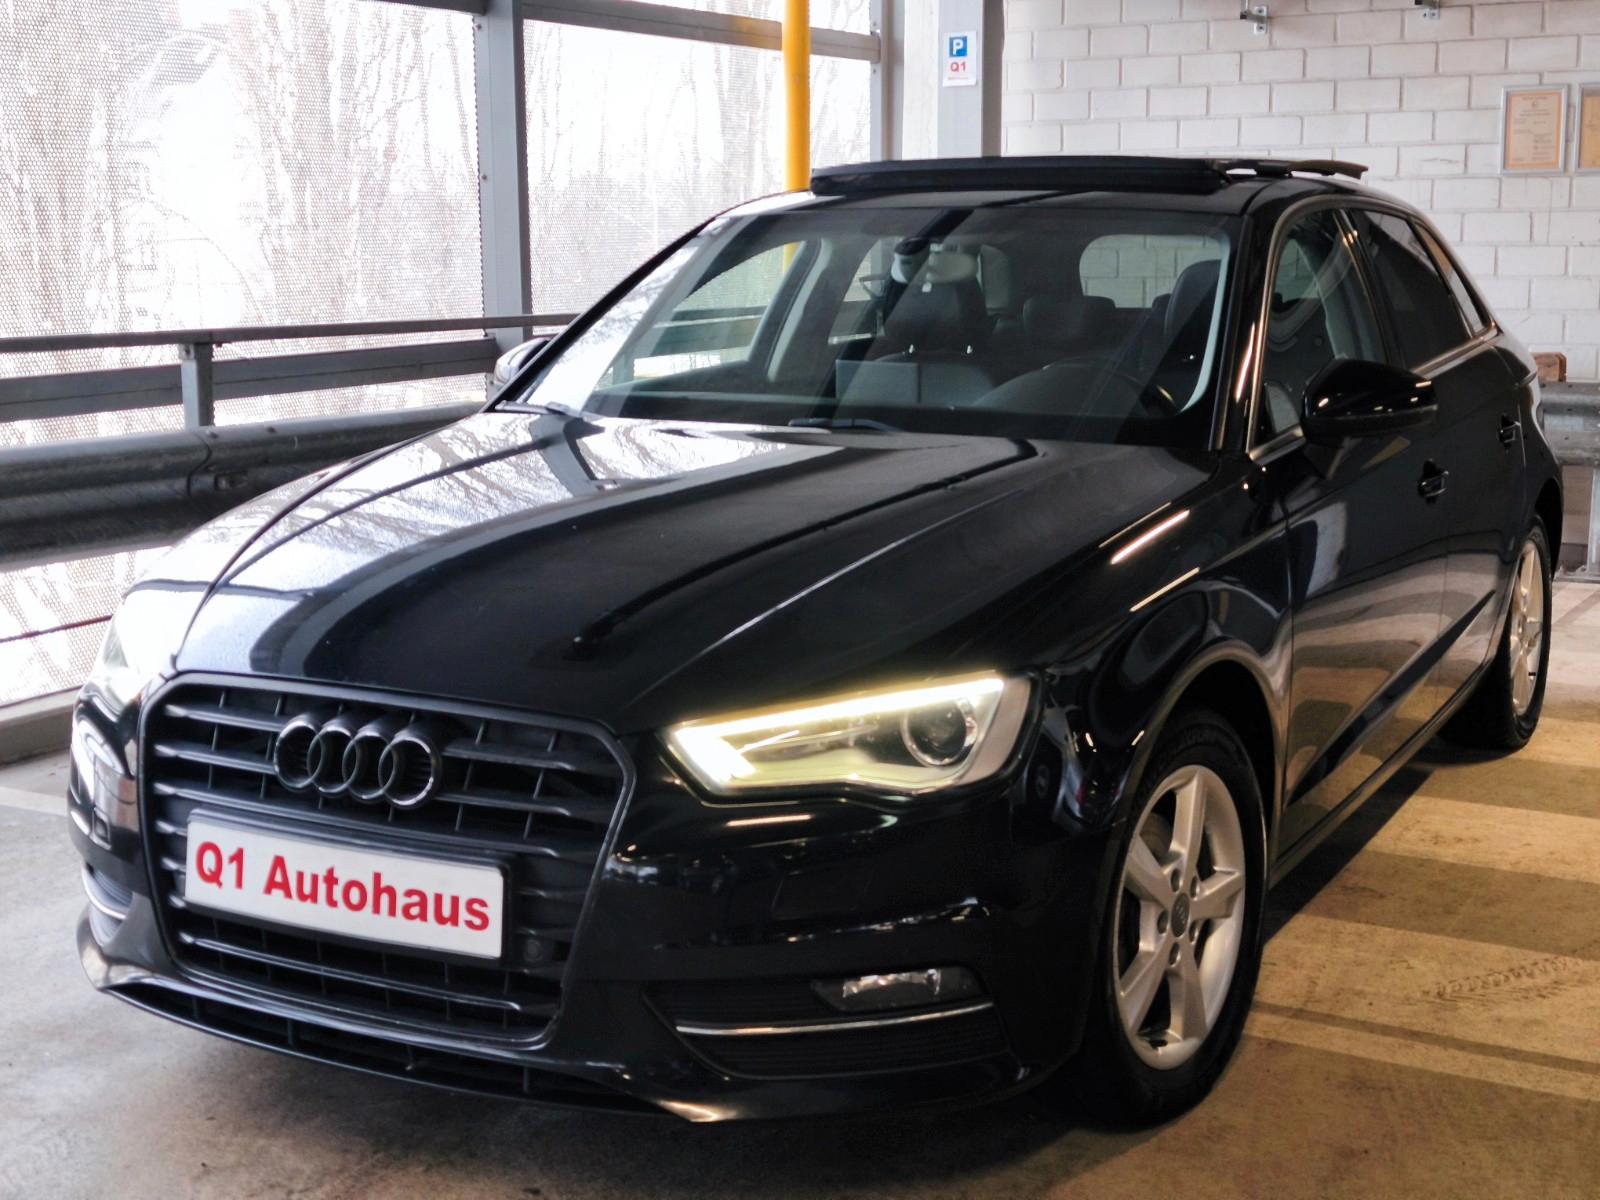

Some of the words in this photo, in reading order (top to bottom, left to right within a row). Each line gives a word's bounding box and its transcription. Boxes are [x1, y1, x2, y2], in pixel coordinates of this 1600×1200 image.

[952, 39, 964, 56] P
[950, 61, 966, 73] Q1
[195, 841, 244, 889] Q1
[263, 854, 490, 931] Autohaus
